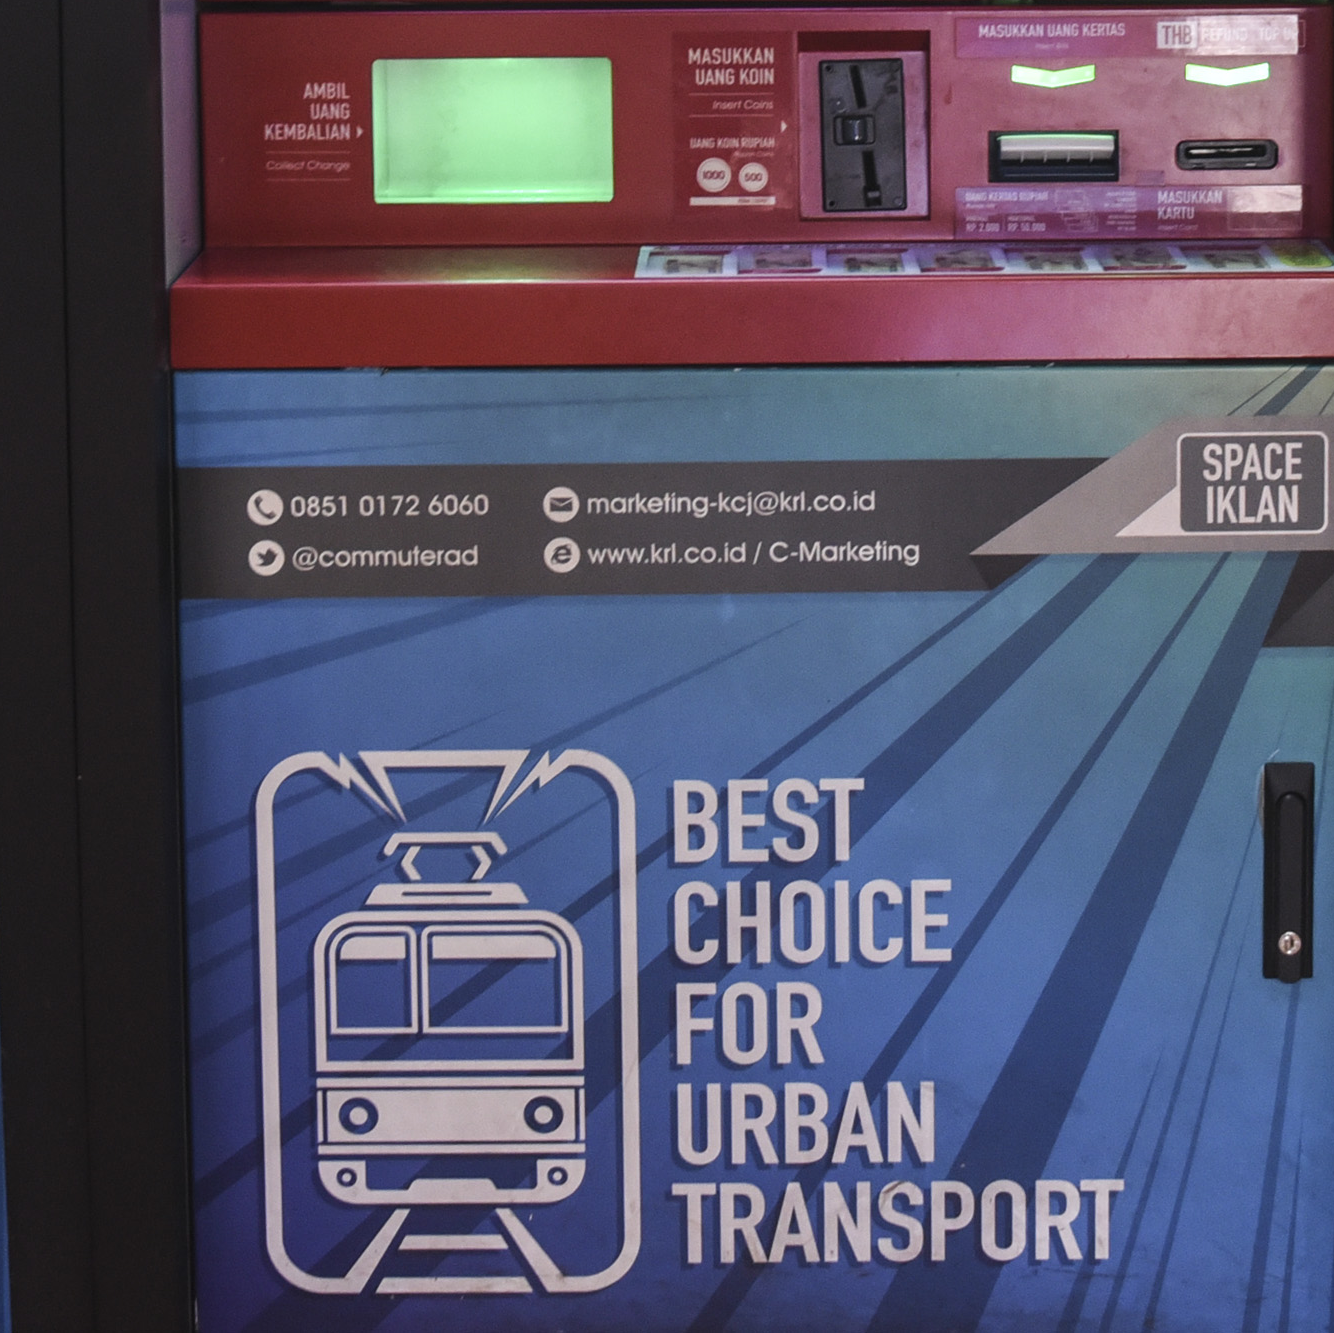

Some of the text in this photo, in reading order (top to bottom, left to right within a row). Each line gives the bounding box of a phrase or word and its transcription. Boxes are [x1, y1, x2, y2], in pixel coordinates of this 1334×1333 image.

[978, 24, 1125, 38] MASUKKAN UANG KERTAS
[1162, 25, 1192, 45] THB
[1201, 27, 1280, 42] REFUND TOP
[688, 47, 775, 66] MASUKKAN
[695, 68, 775, 86] UANG KOIN
[303, 82, 351, 100] AMBIL
[309, 103, 351, 120] UANG
[712, 98, 774, 110] Insert Coins
[264, 123, 351, 141] KEMBALIAN
[1157, 190, 1223, 204] MASUKKAN
[1157, 207, 1194, 220] KARTU
[1202, 442, 1303, 482] SPACE
[290, 494, 489, 517] 0851 0172 6060
[587, 490, 876, 518] marketing-kcj@krl.co.id
[1206, 485, 1299, 524] IKLAN
[292, 545, 478, 571] @commuterad
[588, 540, 921, 566] www.krl.co.id / C-Marketing
[672, 778, 865, 863] BEST
[673, 878, 953, 965] CHOICE
[675, 981, 825, 1066] FOR
[676, 1080, 936, 1165] URBAN
[672, 1178, 1125, 1264] TRANSPORT
